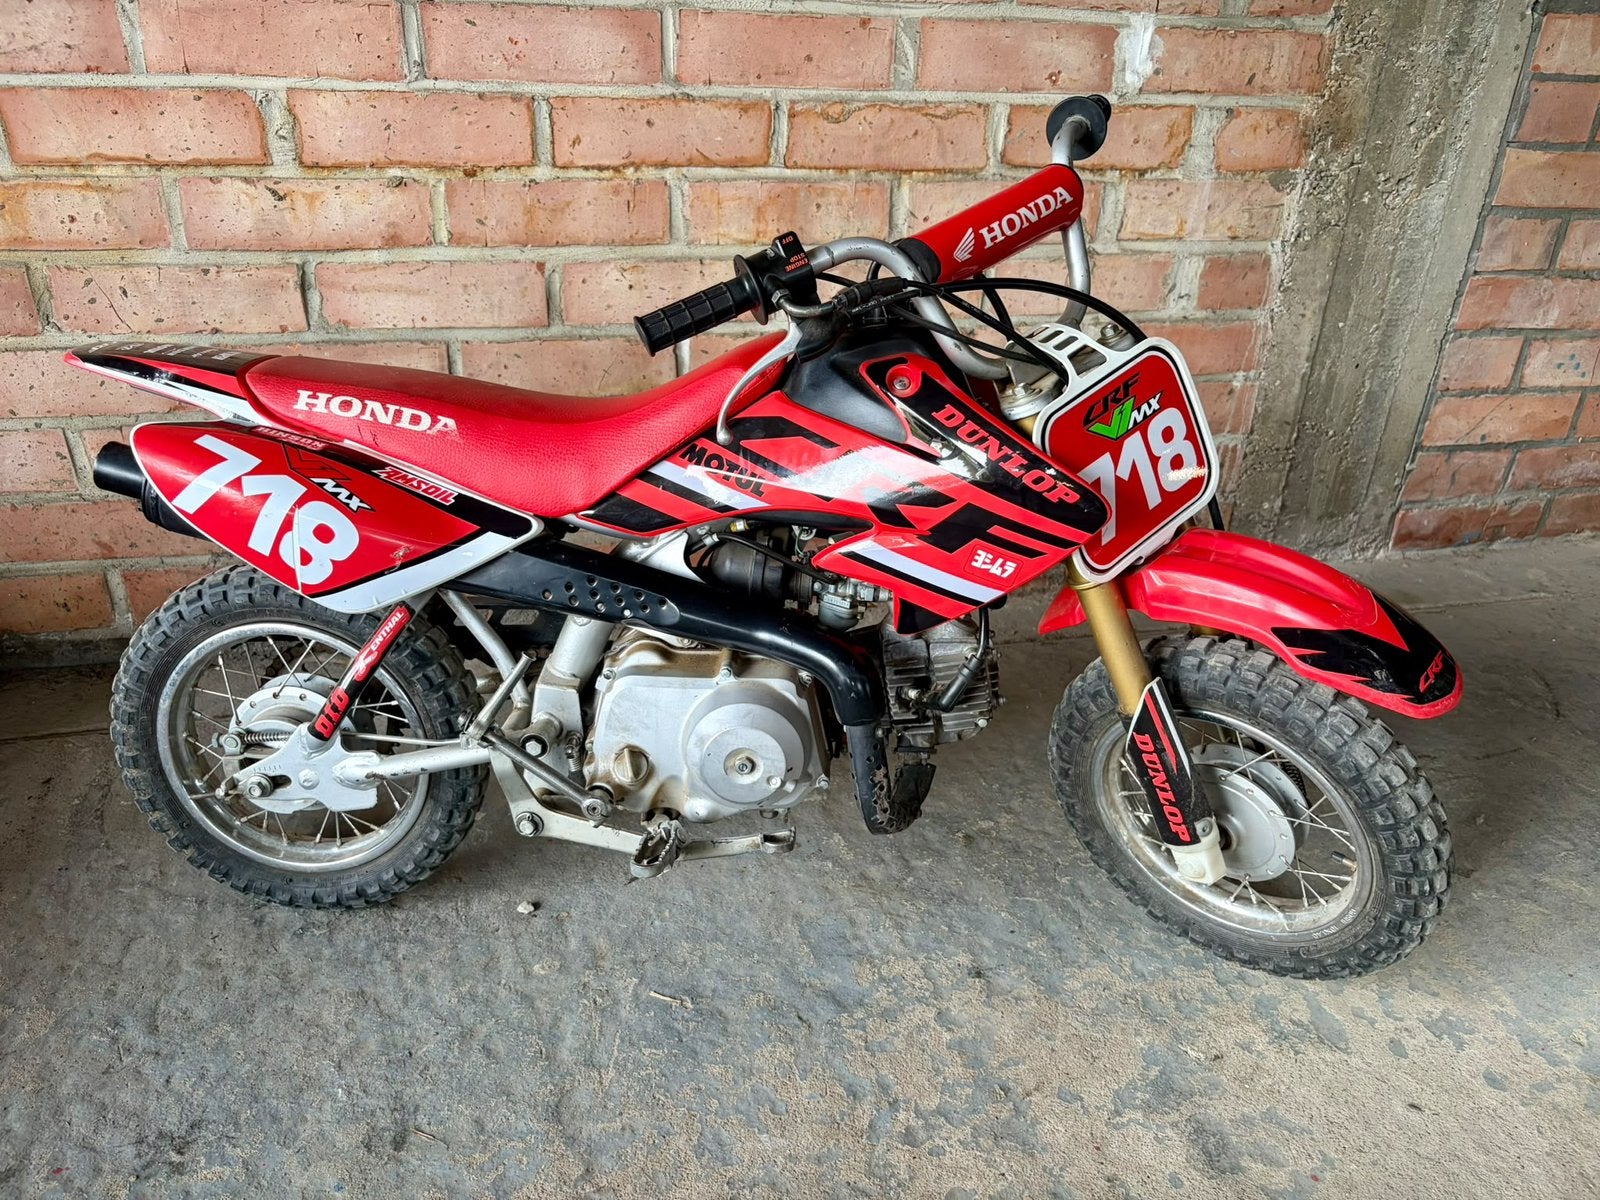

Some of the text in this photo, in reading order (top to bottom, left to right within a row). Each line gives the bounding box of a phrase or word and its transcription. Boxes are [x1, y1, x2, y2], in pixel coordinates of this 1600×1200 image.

[782, 235, 794, 245] OFF
[979, 186, 1074, 250] HONDA
[293, 389, 462, 440] HONDA
[679, 443, 766, 498] MOTUL
[931, 404, 1081, 504] DUNLOP
[1077, 407, 1198, 547] 718
[171, 434, 360, 585] 718
[371, 466, 459, 506] AMSOIL
[971, 549, 1018, 578] ヨシムラ
[1133, 732, 1191, 842] DUNLOP
